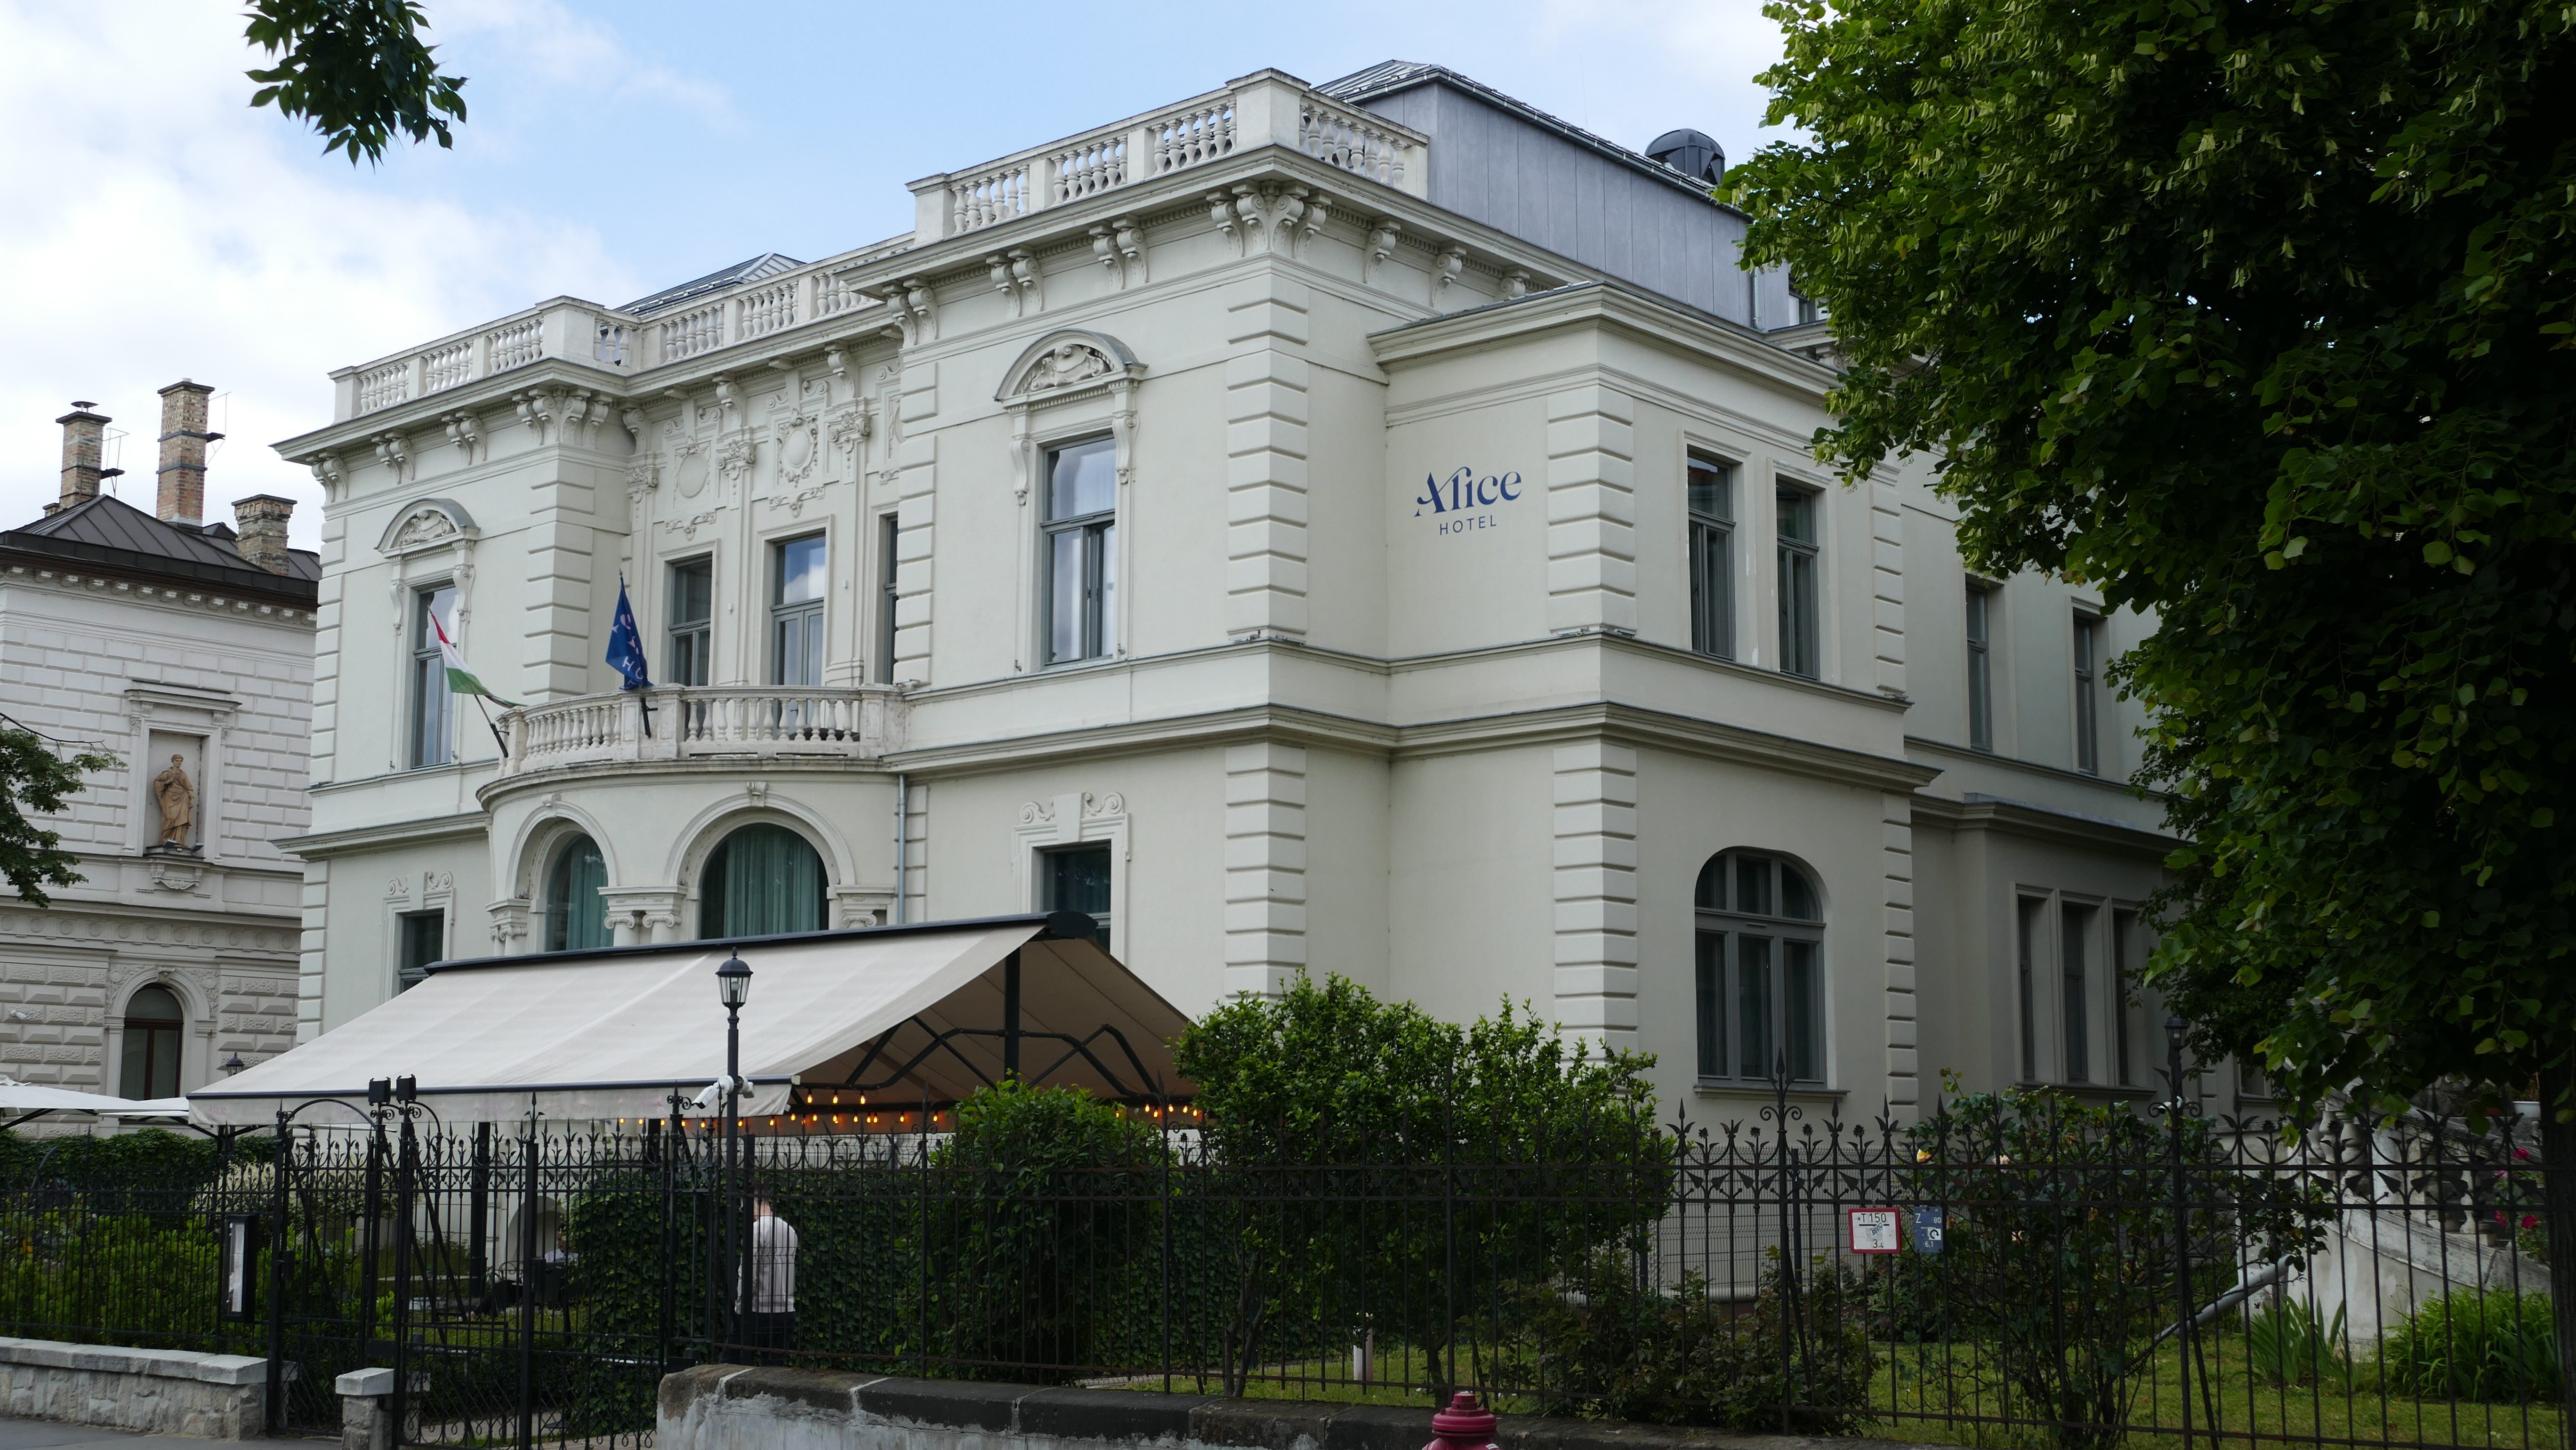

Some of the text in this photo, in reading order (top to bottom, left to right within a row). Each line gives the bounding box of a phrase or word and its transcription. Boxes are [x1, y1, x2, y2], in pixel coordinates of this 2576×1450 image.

[1414, 467, 1522, 517] Alice
[1440, 515, 1497, 536] HOTEL
[1916, 1213, 1922, 1223] Z
